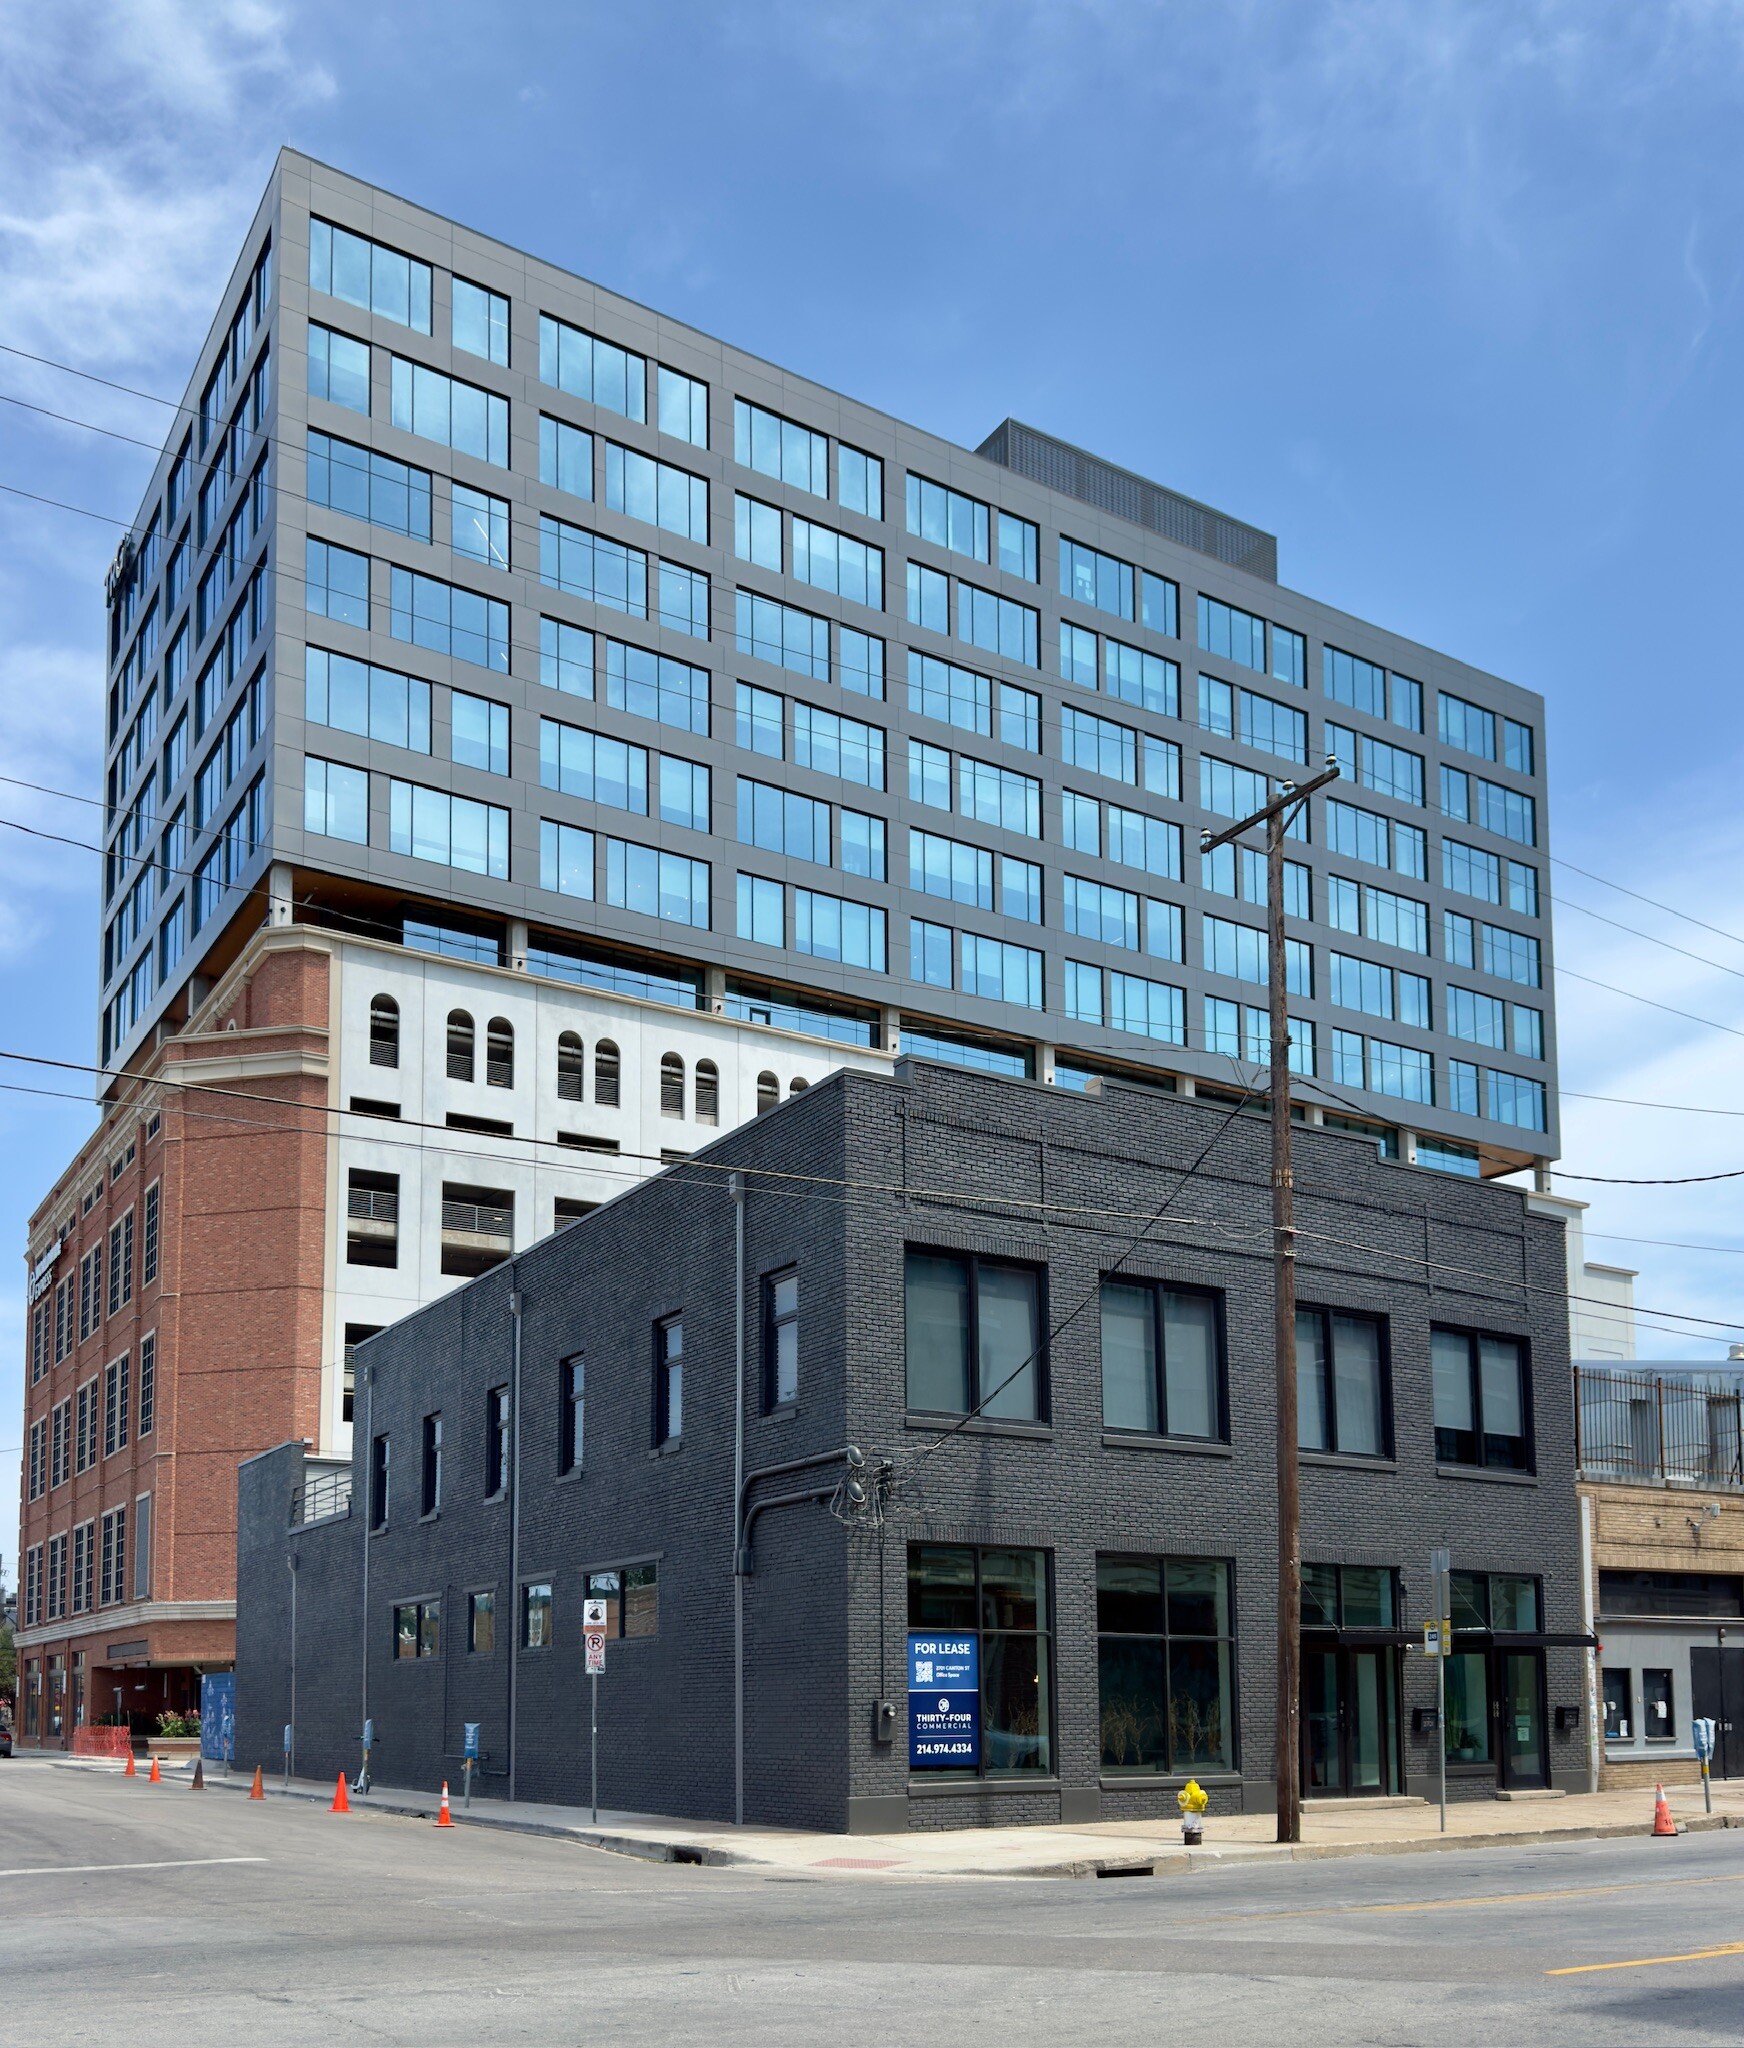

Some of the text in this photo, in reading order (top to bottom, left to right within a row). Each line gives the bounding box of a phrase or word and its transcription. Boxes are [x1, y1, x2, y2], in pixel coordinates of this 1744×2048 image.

[915, 1643, 970, 1655] FOR LEASE
[916, 1714, 972, 1722] THIRTY-FOUR
[916, 1743, 972, 1754] 214.974.4334
